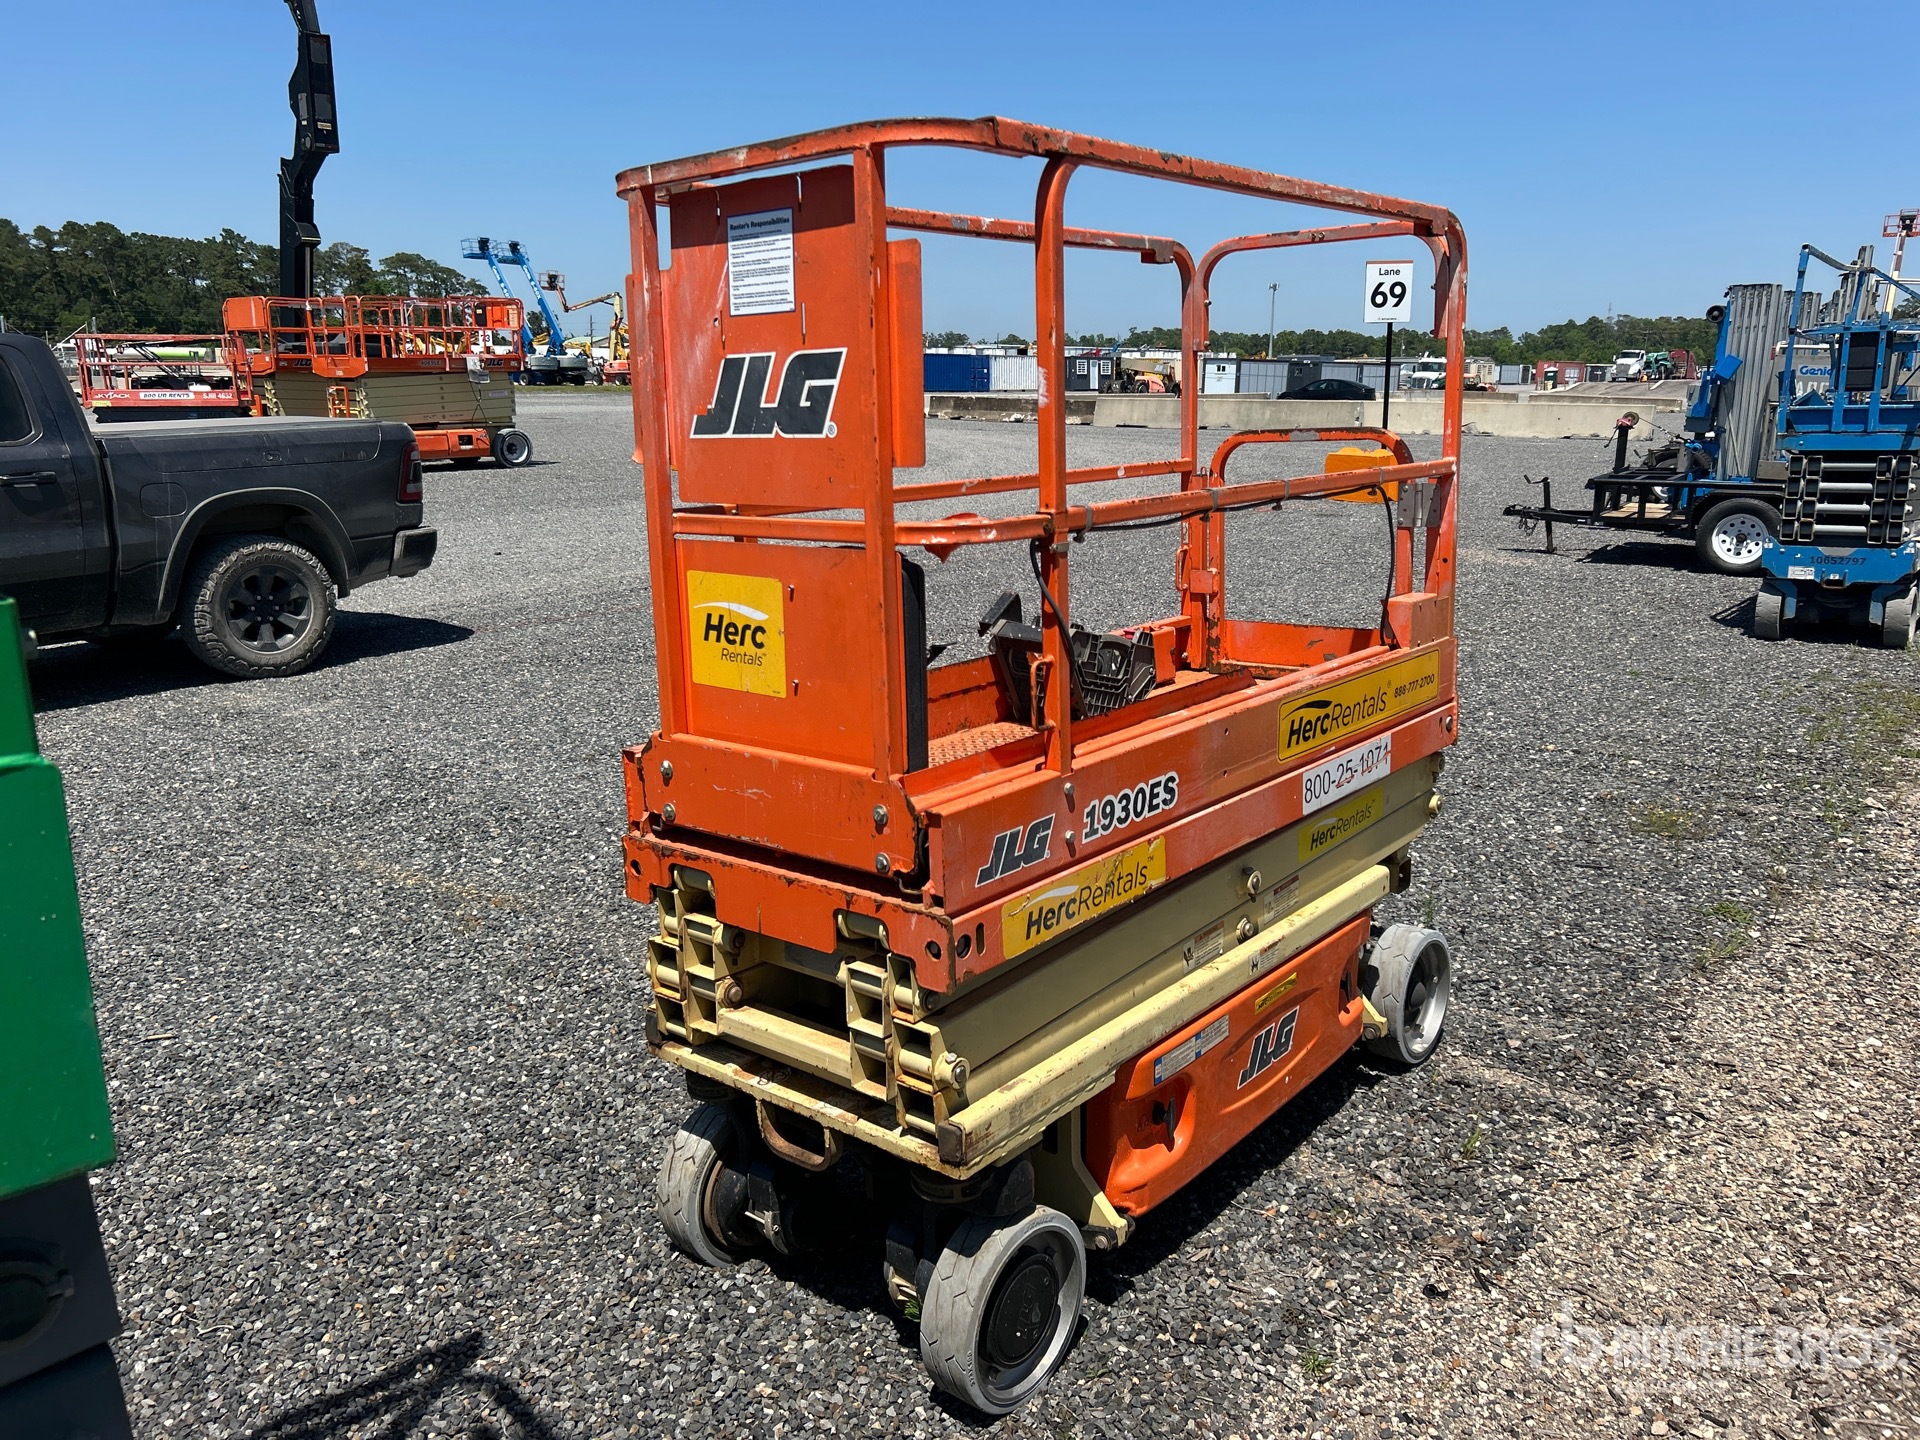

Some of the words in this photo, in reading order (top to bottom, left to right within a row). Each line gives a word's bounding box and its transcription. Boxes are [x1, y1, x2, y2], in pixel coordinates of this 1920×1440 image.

[1370, 281, 1407, 309] 69
[1379, 267, 1401, 276] Lane
[487, 359, 504, 368] JLG
[689, 347, 848, 439] JLG
[1810, 555, 1867, 566] 10652797
[704, 612, 767, 650] Herc
[721, 648, 763, 667] Rentals
[1286, 687, 1388, 749] HercRentals
[1394, 673, 1435, 698] 888-777-2700
[1304, 741, 1390, 804] 800-25-1071
[1082, 771, 1180, 844] 1930ES
[975, 813, 1056, 888] JLG
[1025, 863, 1149, 941] HercRentals
[1237, 1005, 1300, 1091] JLG
